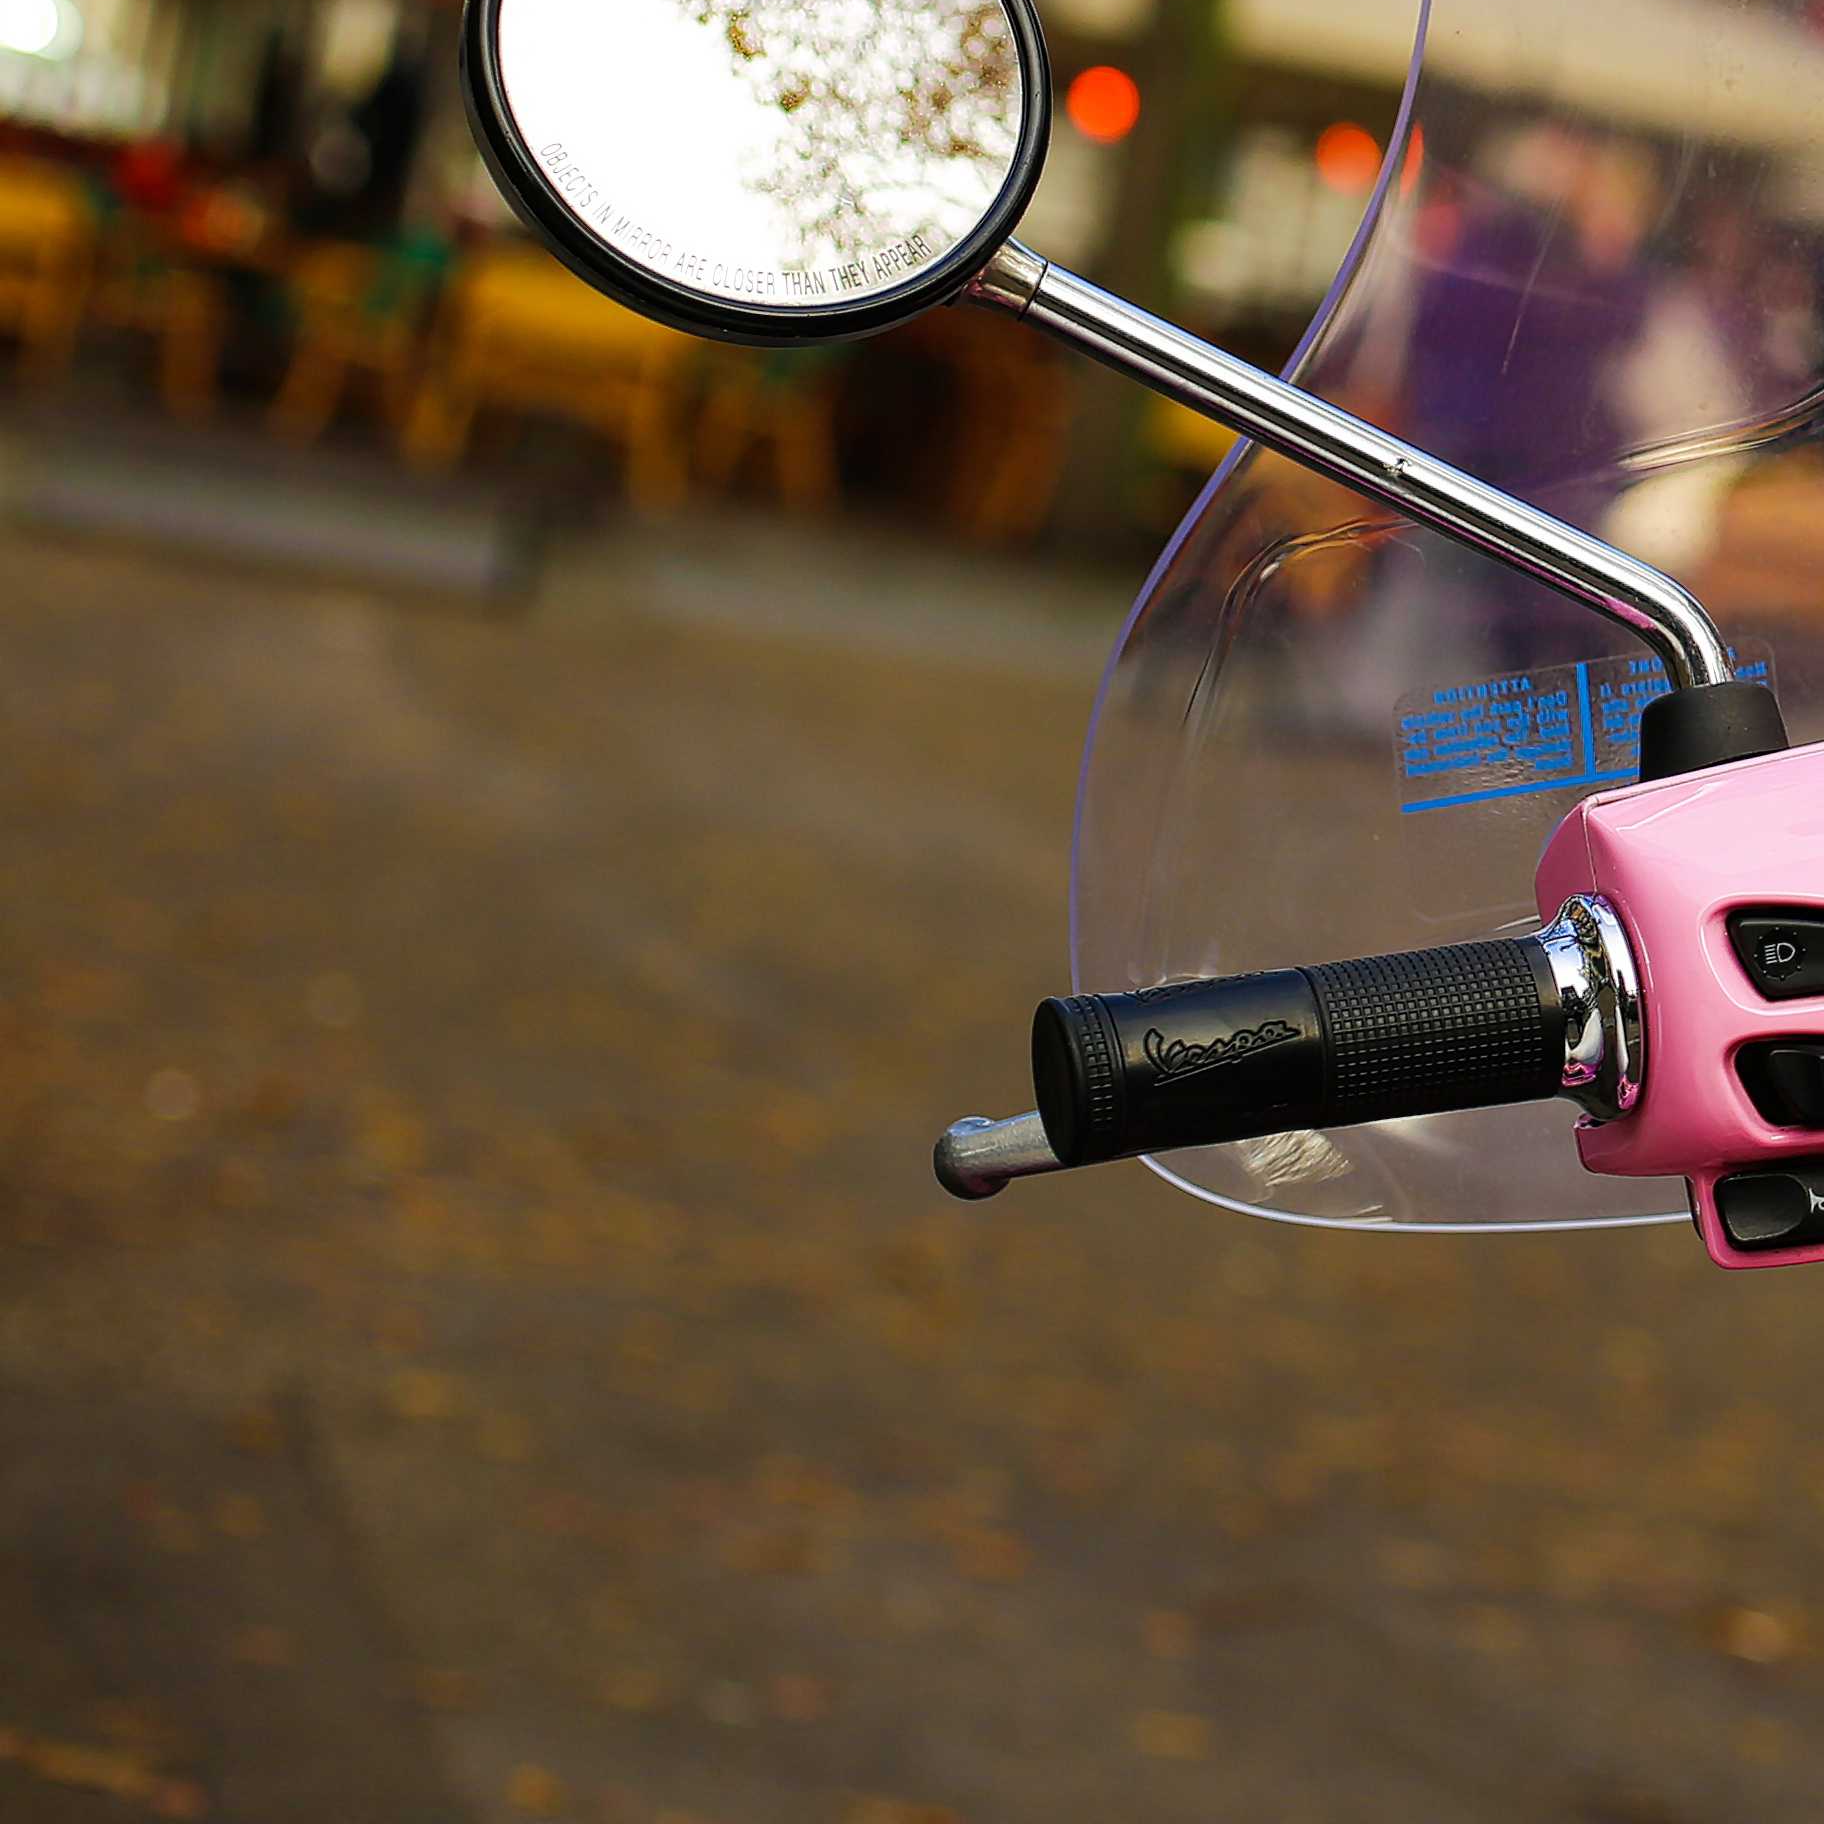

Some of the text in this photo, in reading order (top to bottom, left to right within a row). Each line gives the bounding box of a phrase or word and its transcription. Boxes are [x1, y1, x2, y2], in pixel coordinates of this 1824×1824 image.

[540, 142, 933, 296] OBJECTS IN MIRROR ARE CLOSER THAN THEY APPEAR
[1143, 1019, 1302, 1086] Vespa
